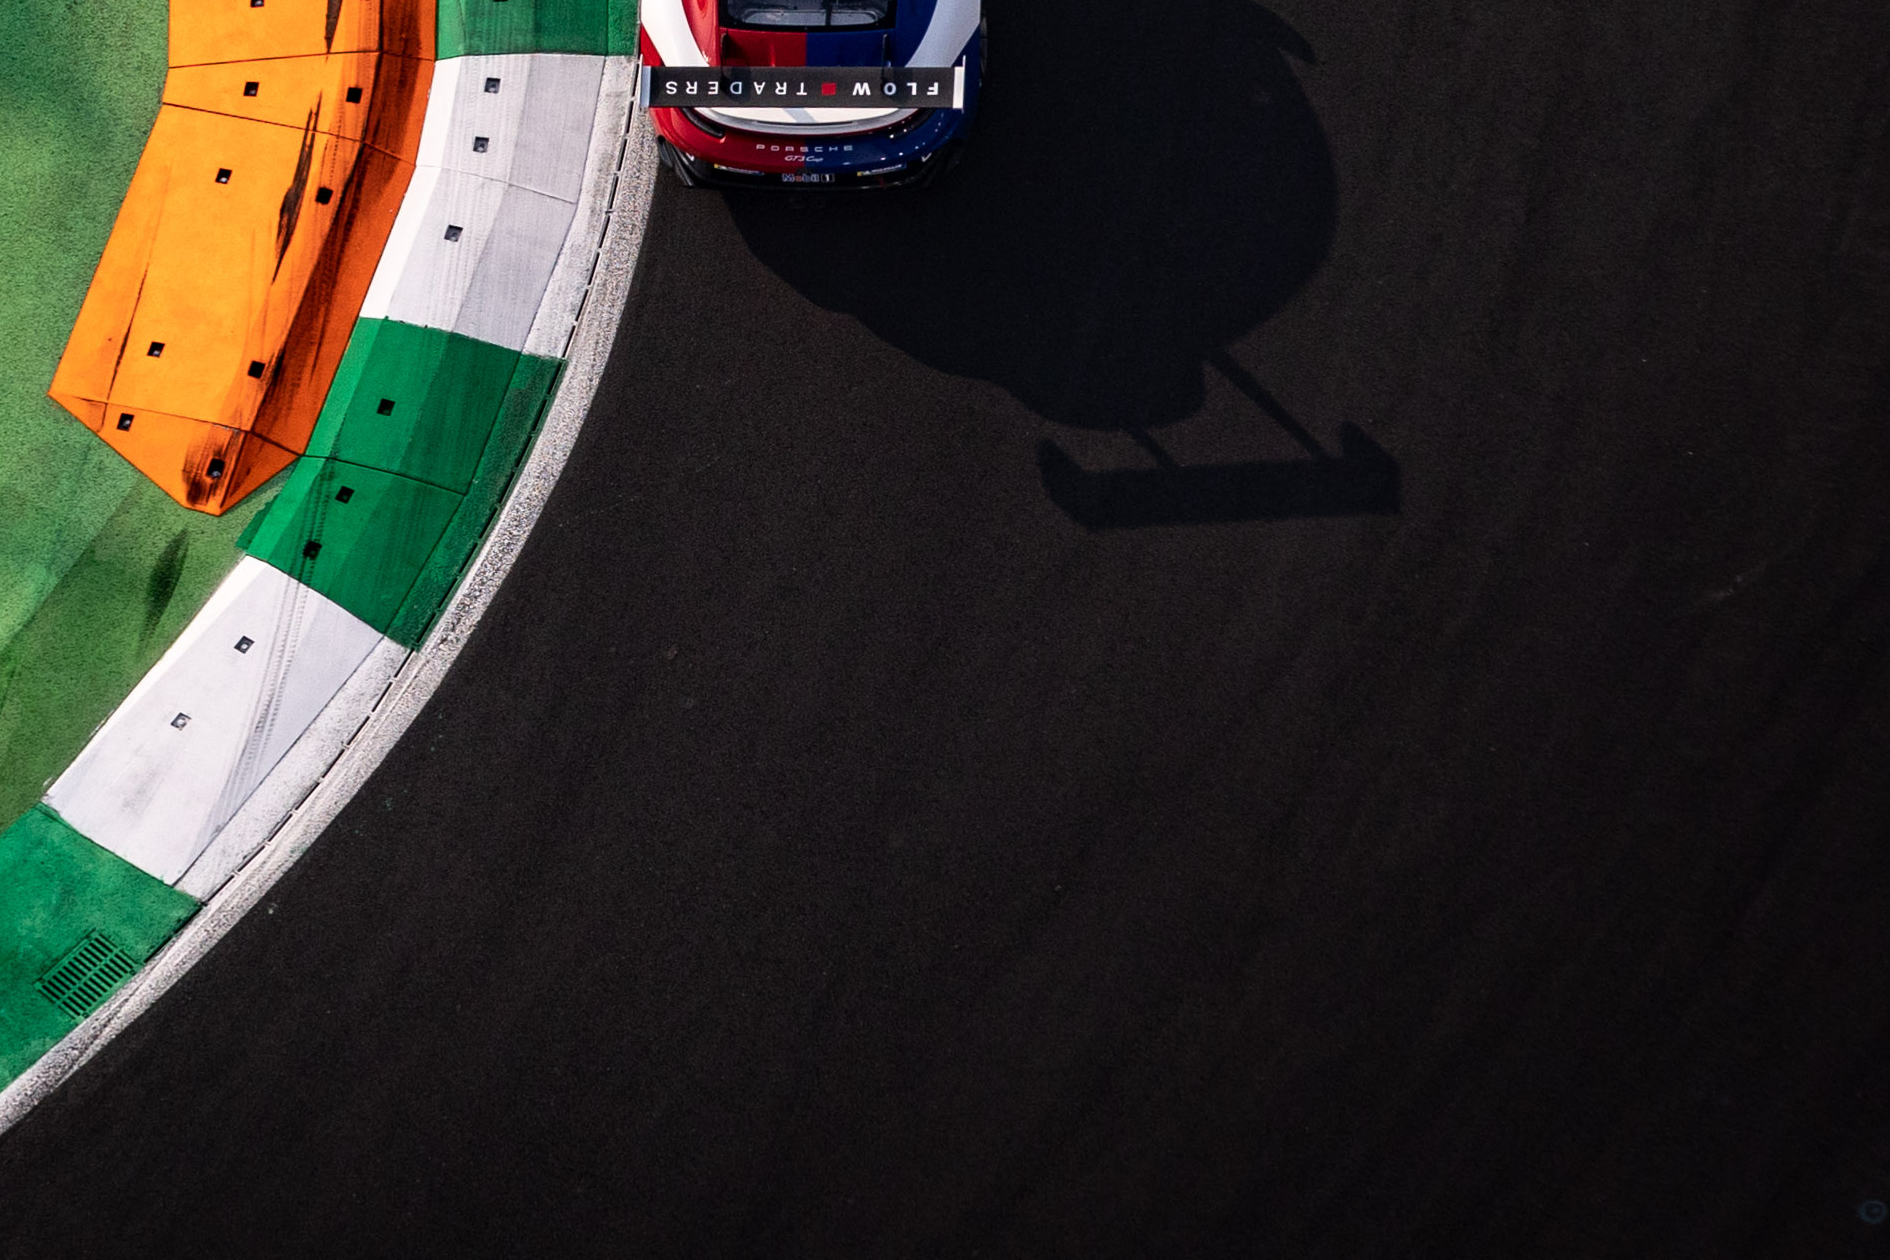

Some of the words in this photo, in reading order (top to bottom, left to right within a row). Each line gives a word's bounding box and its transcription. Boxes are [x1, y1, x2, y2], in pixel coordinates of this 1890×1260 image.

[665, 81, 808, 95] TRADERS
[852, 82, 939, 96] FLOW
[756, 144, 853, 153] PORSCHE
[781, 173, 820, 182] Mobil
